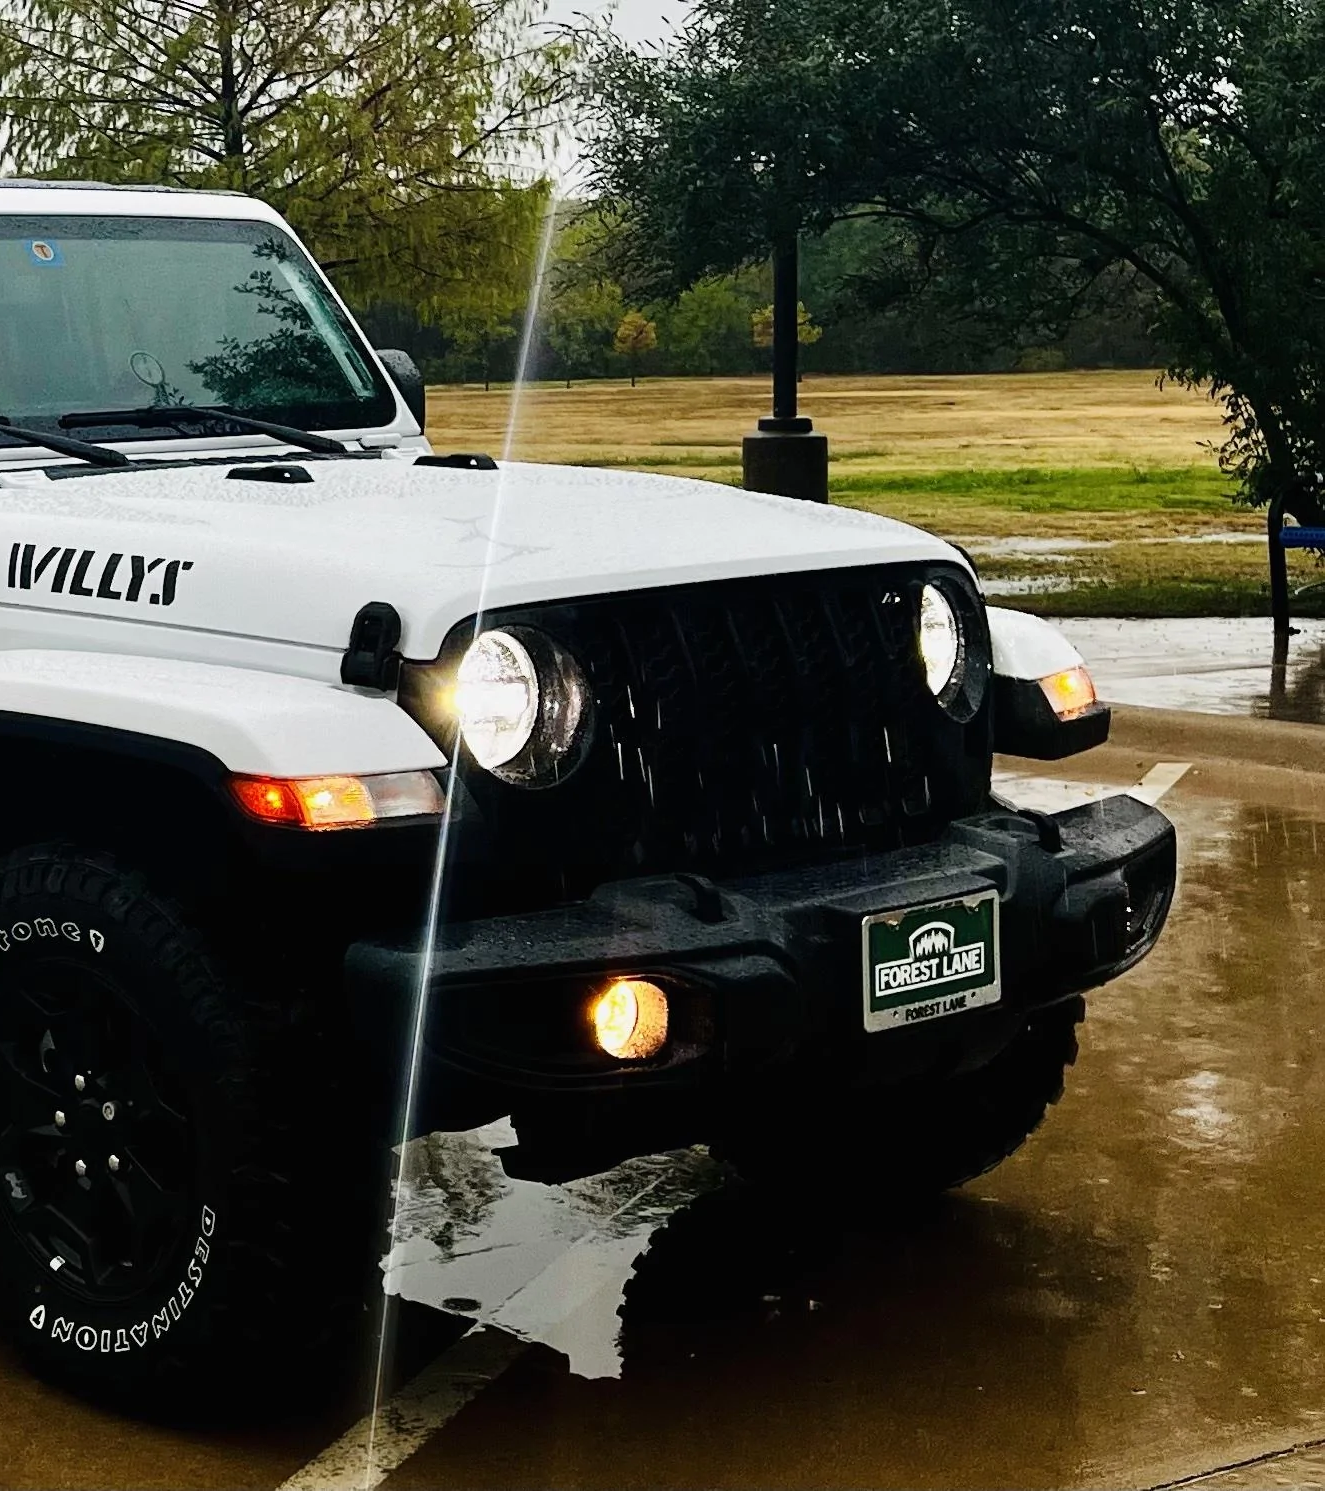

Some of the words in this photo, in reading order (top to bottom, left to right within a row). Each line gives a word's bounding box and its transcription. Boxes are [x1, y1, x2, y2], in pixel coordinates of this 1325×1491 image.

[7, 542, 195, 606] WILLYS
[880, 958, 939, 990] FOREST
[942, 948, 981, 977] LANE
[905, 1000, 941, 1022] FOREST
[942, 995, 967, 1013] LANE
[51, 1204, 216, 1353] DESTINATION
